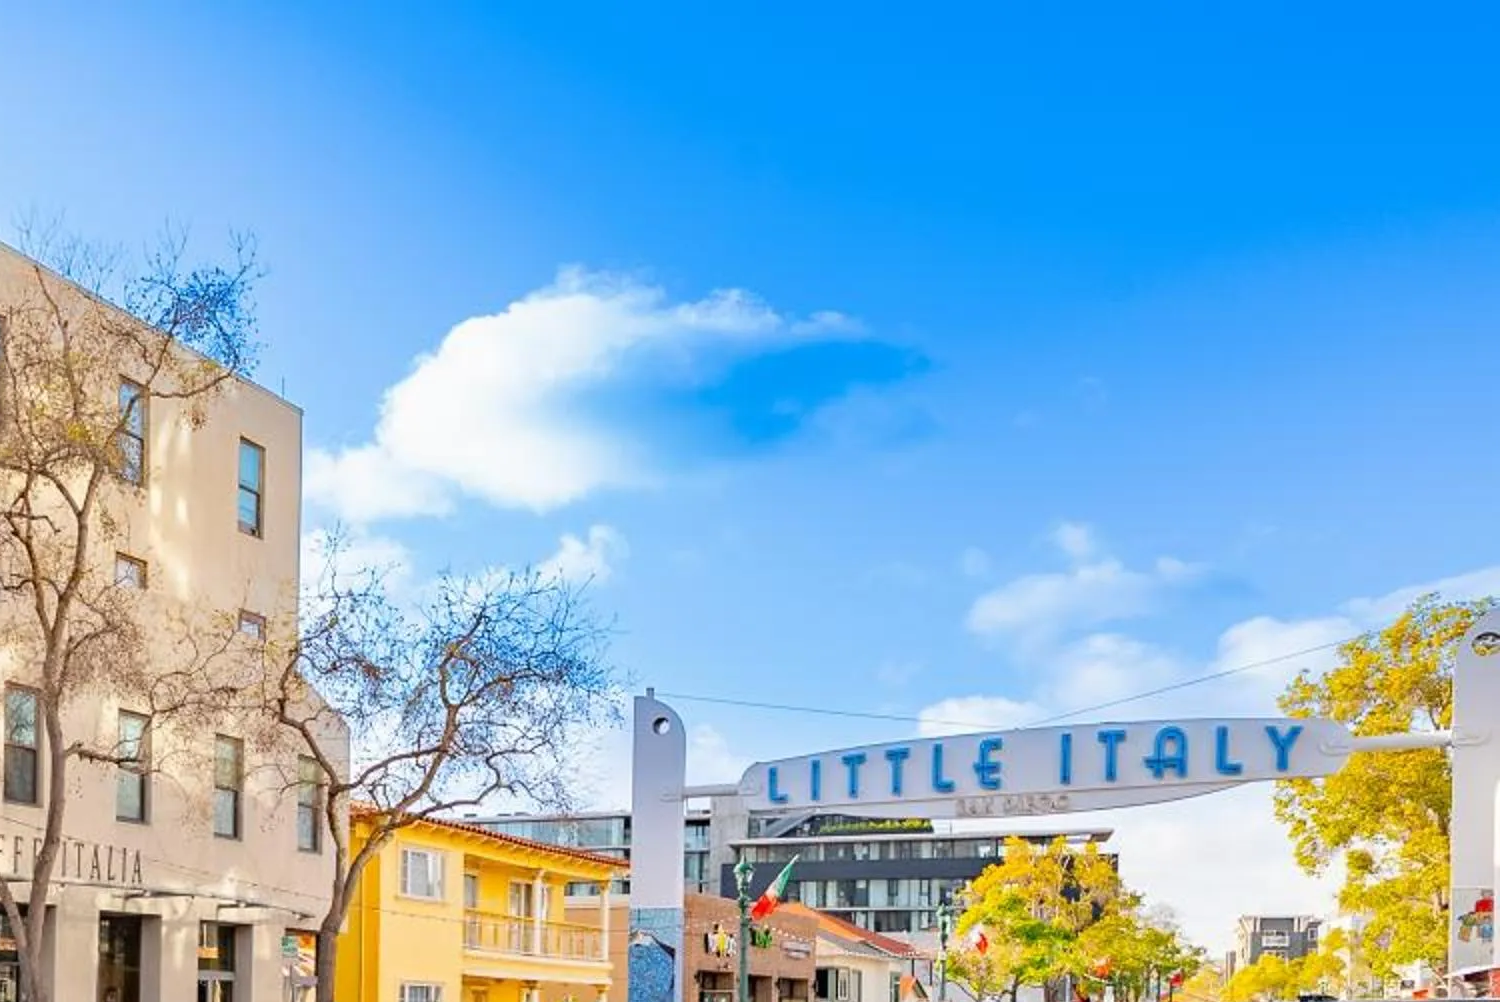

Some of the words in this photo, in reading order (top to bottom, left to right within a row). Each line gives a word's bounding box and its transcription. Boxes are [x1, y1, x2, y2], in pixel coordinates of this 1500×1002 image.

[767, 737, 1003, 804] LITTLE
[1059, 725, 1305, 786] ITALY
[60, 840, 143, 884] ITALIA
